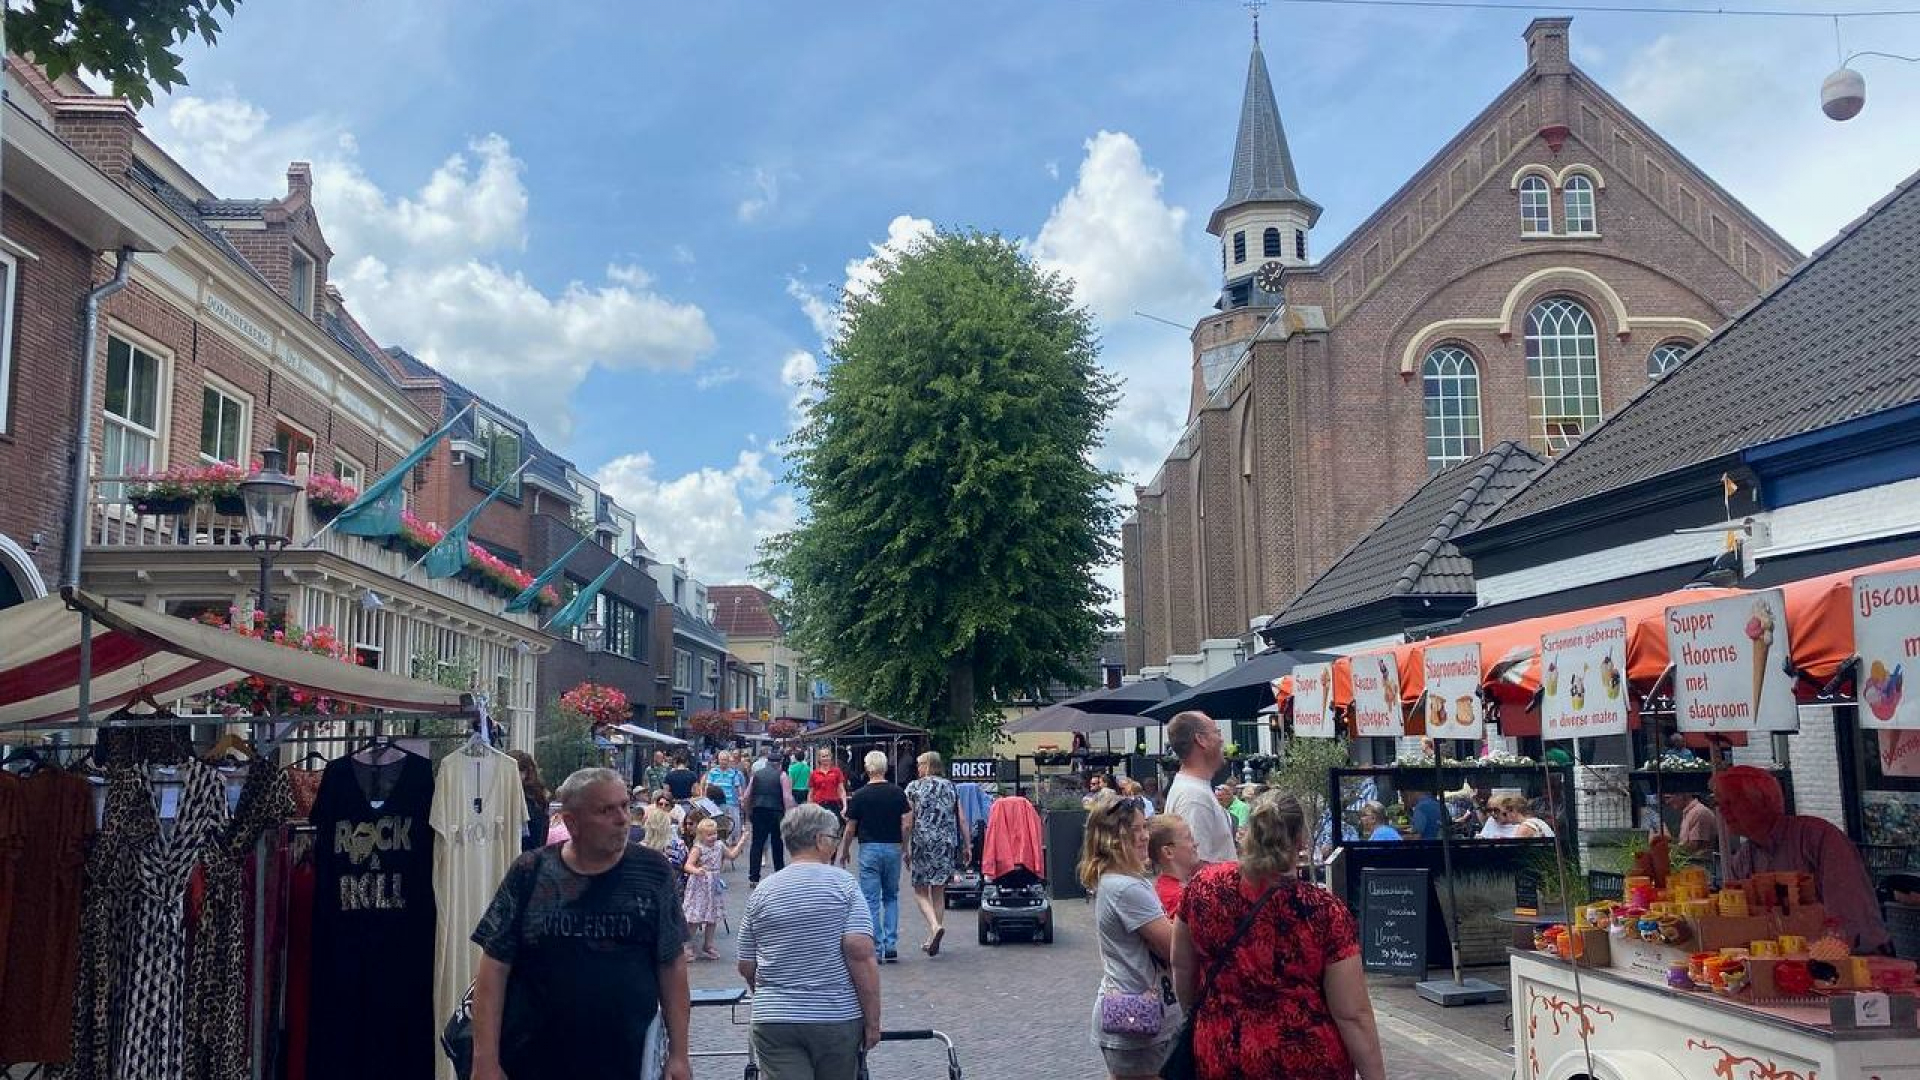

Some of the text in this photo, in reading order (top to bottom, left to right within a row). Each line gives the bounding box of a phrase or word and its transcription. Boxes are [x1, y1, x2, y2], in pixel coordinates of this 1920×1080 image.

[1670, 611, 1714, 639] Super
[1682, 642, 1738, 665] Hoorns
[1296, 675, 1318, 696] Super
[1685, 672, 1709, 691] met
[1689, 699, 1749, 726] slagroom
[952, 762, 995, 777] ROEST.
[340, 873, 405, 911] ROLL
